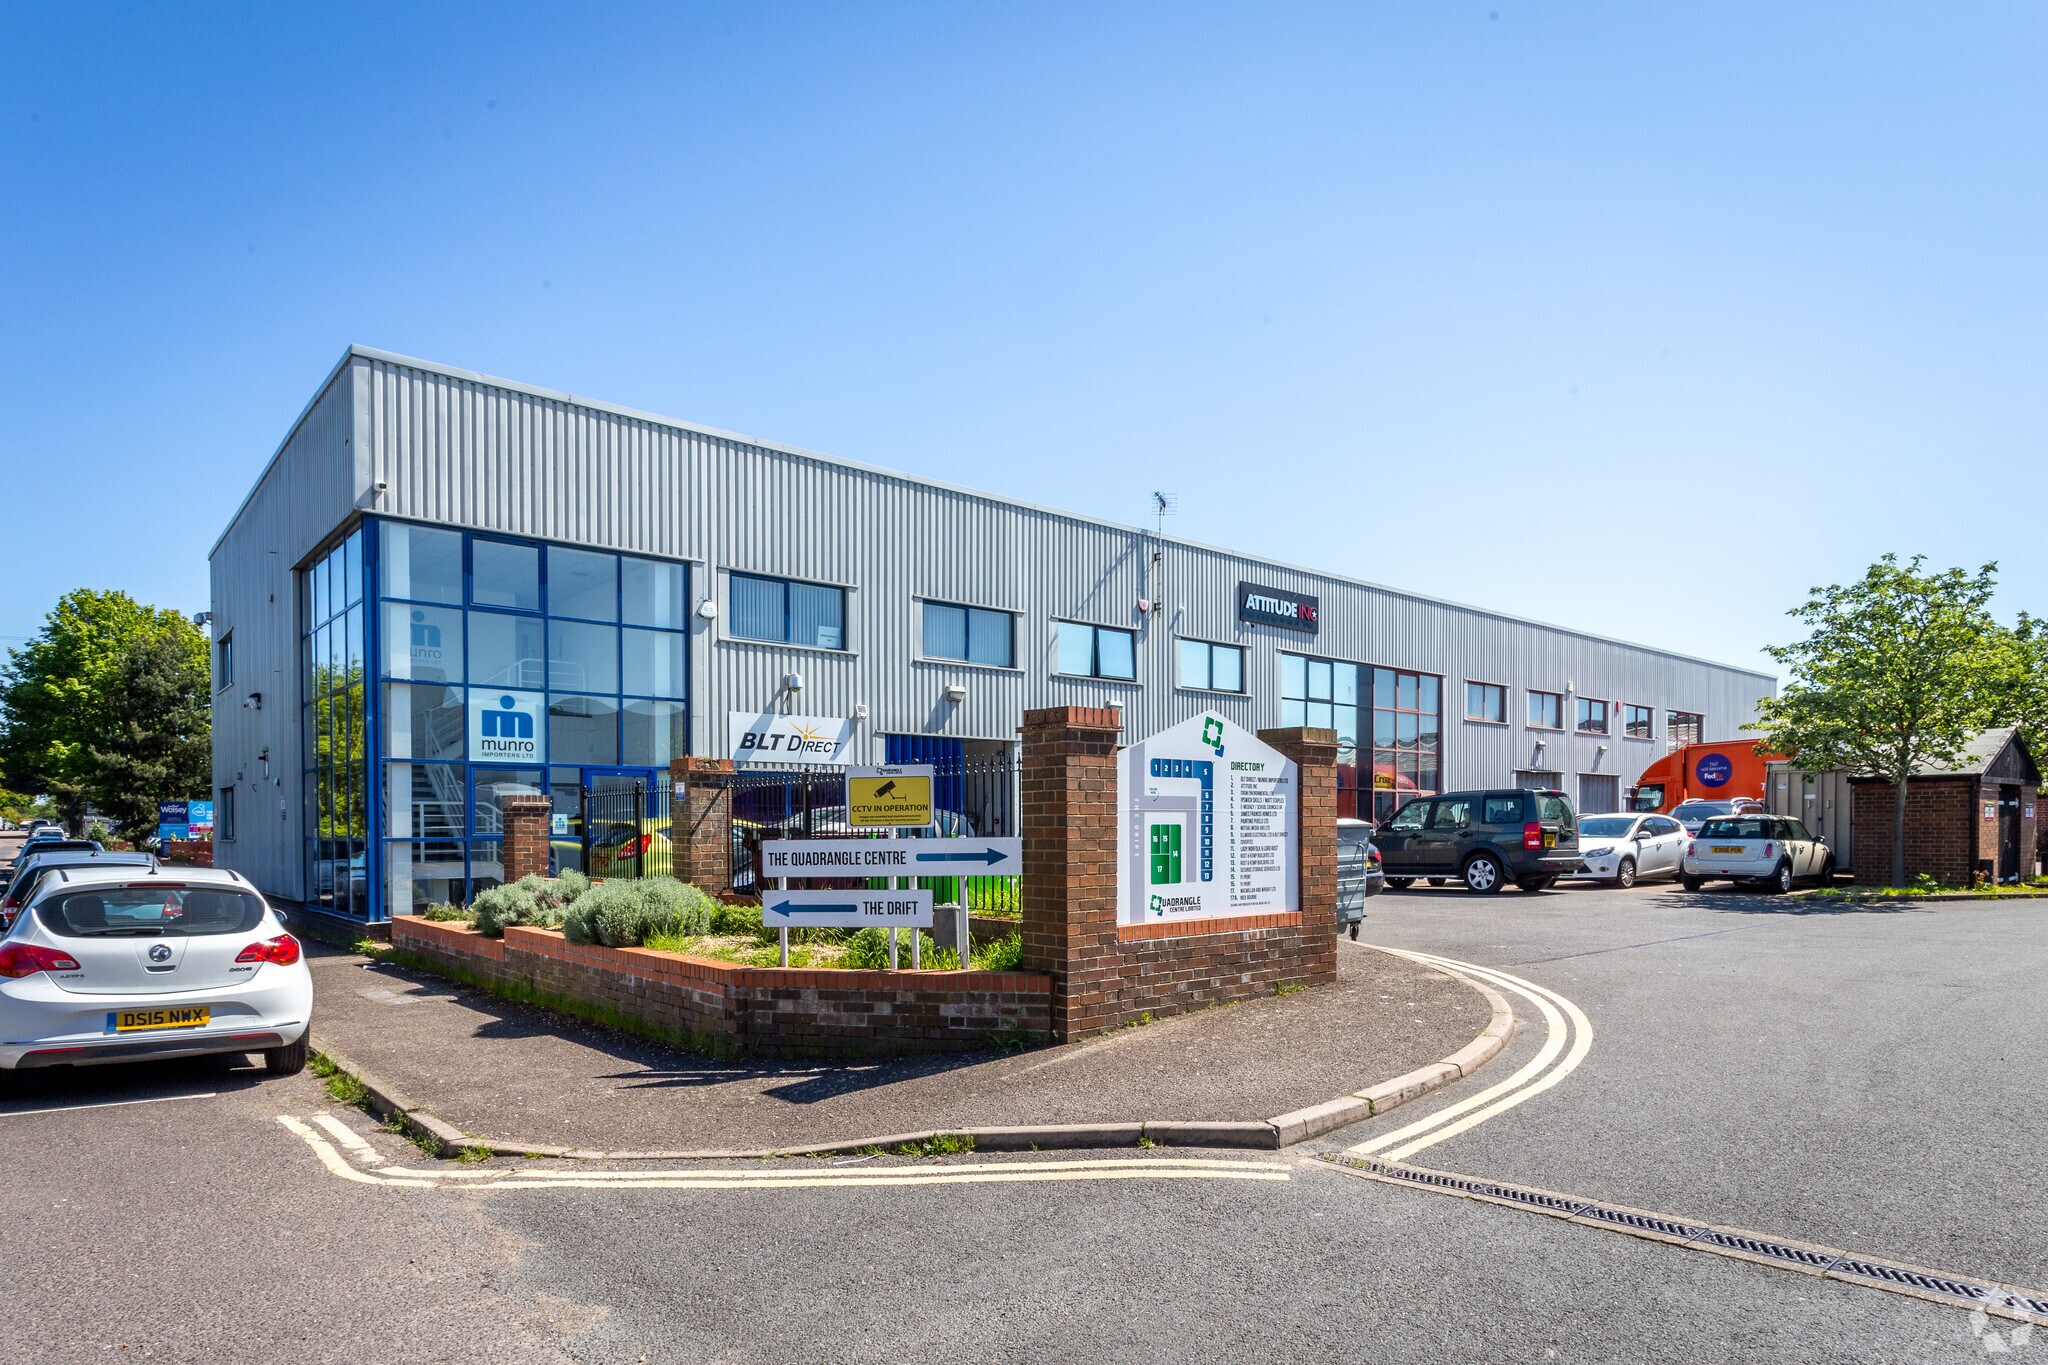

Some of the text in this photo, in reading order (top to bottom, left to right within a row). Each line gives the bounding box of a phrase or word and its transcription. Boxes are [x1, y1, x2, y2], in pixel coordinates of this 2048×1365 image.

[1245, 594, 1317, 621] ATTITUDE INC
[410, 649, 441, 659] unro
[482, 739, 534, 752] munro
[740, 732, 841, 759] BLT DIRECT
[1231, 761, 1265, 771] DIRECTORY
[160, 806, 187, 814] Wolsey
[884, 804, 928, 812] OPERATION
[768, 851, 906, 866] THE QUADRANGLE CENTRE
[864, 901, 918, 915] THE DRIFT
[124, 1008, 203, 1026] DS15 NWX
